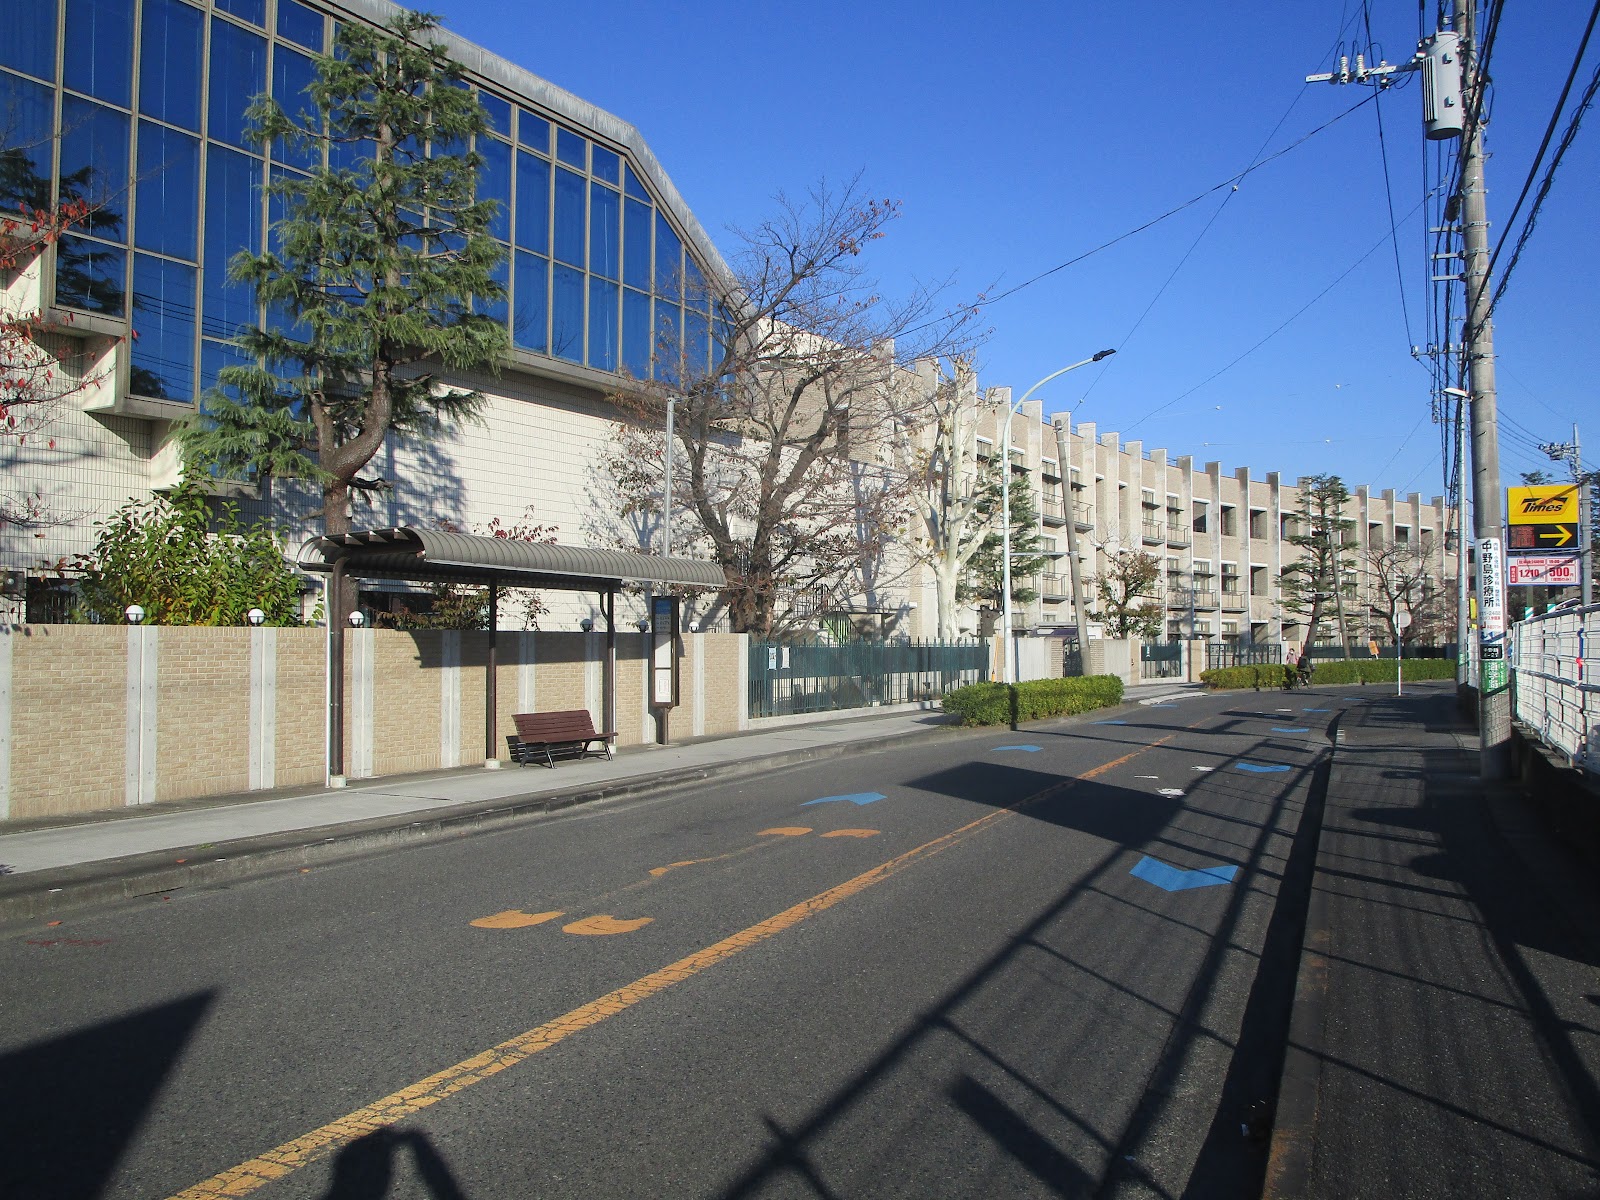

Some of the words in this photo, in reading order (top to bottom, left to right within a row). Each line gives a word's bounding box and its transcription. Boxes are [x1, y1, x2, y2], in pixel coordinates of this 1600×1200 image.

[1521, 497, 1569, 513] Times
[1481, 540, 1494, 608] 中野島診療所
